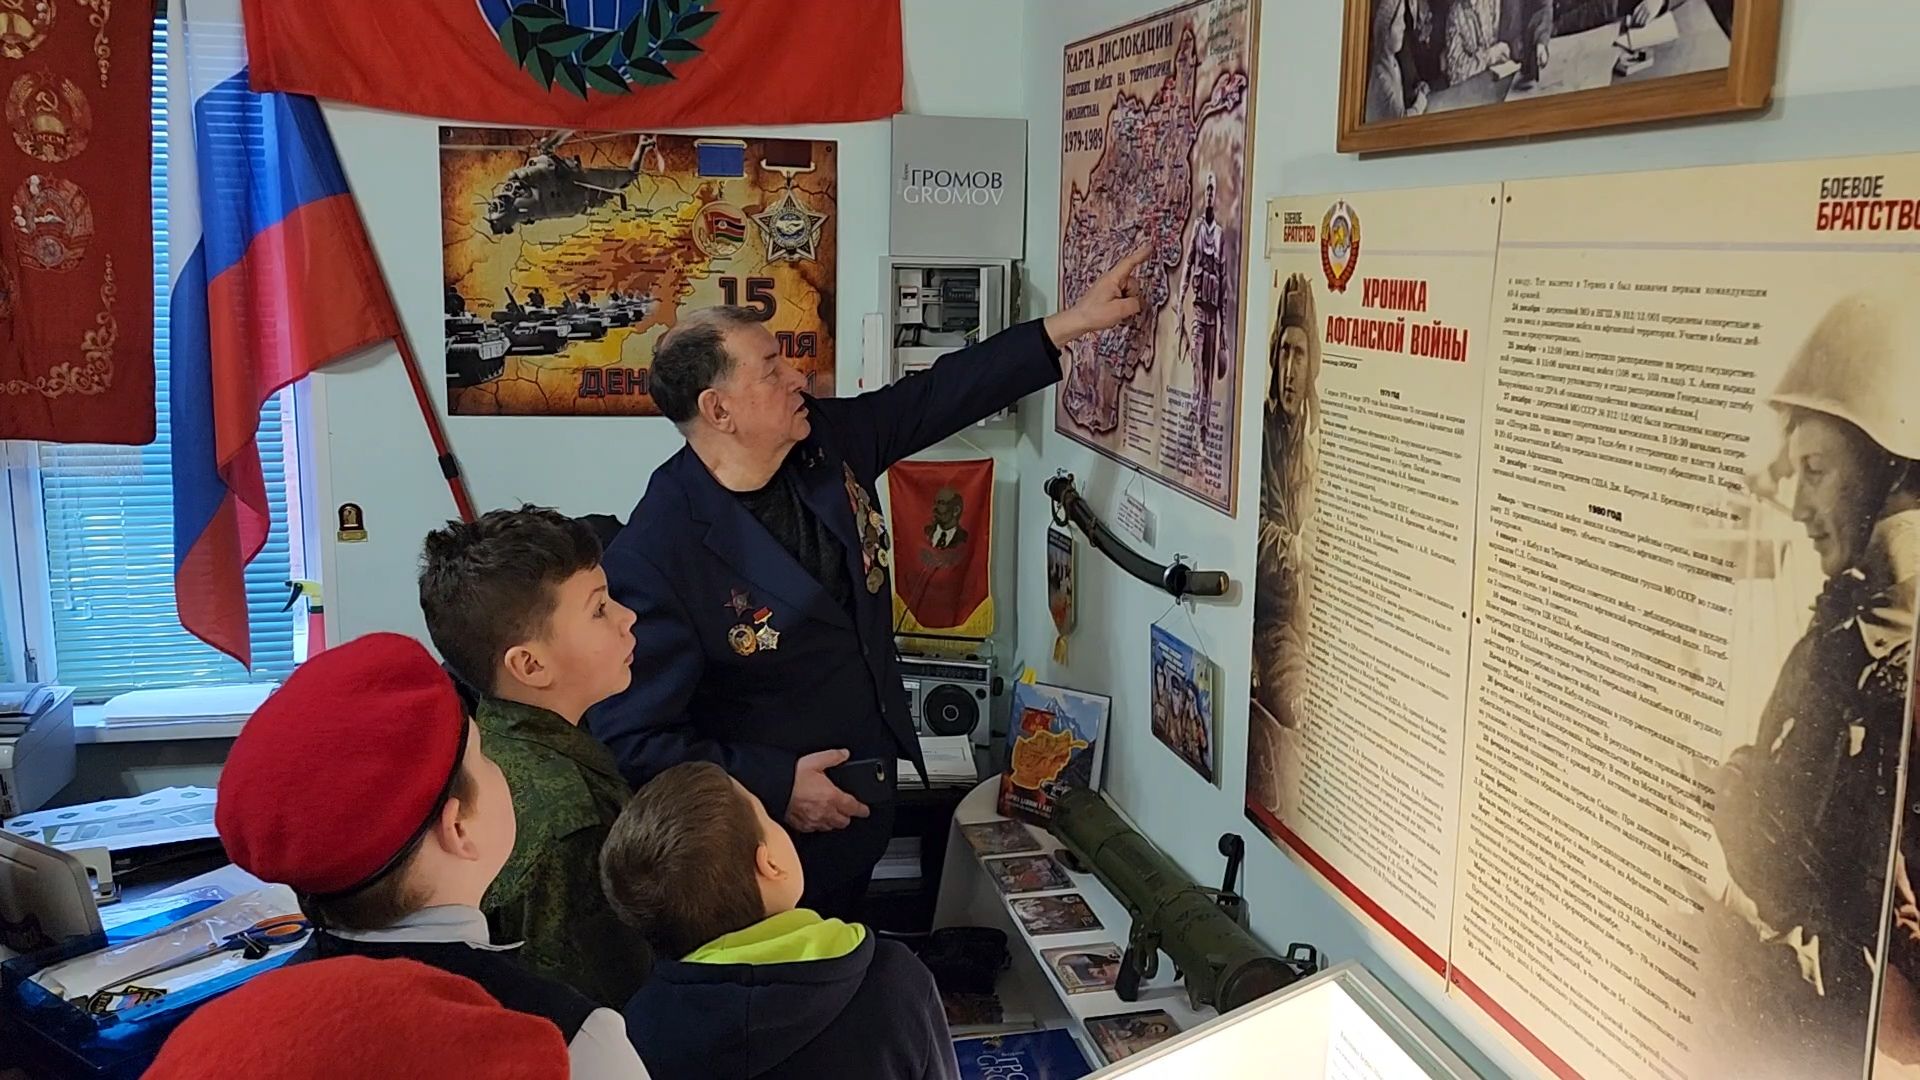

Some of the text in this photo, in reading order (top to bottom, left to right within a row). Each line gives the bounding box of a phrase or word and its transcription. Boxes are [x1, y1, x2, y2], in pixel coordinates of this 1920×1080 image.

[1066, 47, 1094, 74] КАРТА
[1097, 22, 1174, 71] ДИСЛОКАЦИИ
[1117, 72, 1126, 86] НА
[1064, 128, 1103, 153] 1979-1989
[911, 168, 1003, 190] ГРОМОВ
[1819, 175, 1885, 200] БОЕВОЕ
[903, 186, 1005, 206] GROMOV
[1283, 225, 1316, 243] БРАТСТВО
[719, 276, 777, 320] 15
[1361, 277, 1427, 313] ХРОНИКА
[1325, 315, 1469, 362] АФГАНСКОЙ ВОЙНЫ
[578, 367, 648, 399] ДЕН
